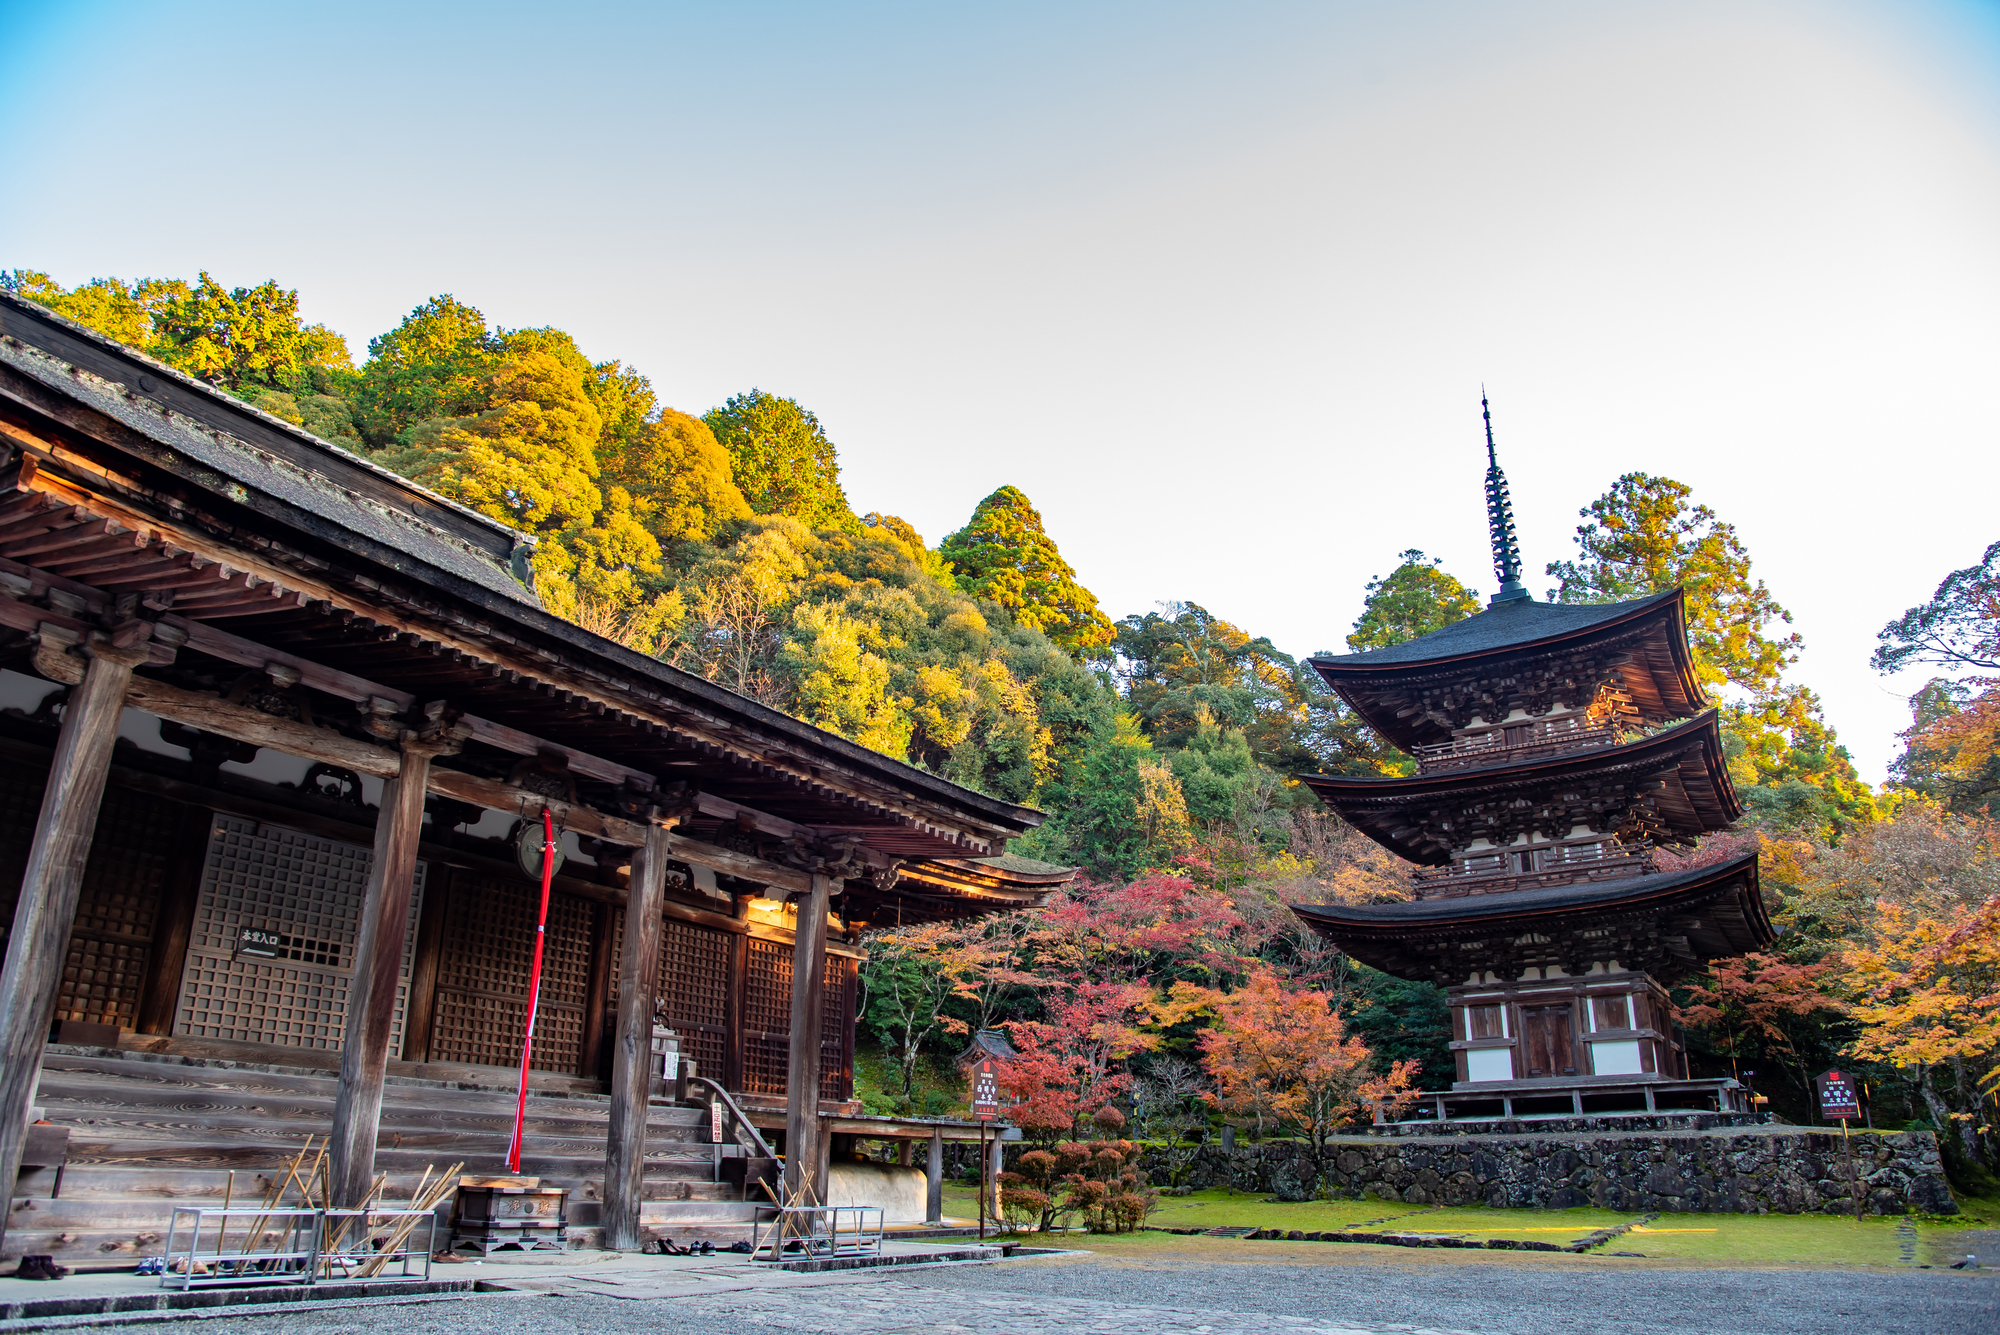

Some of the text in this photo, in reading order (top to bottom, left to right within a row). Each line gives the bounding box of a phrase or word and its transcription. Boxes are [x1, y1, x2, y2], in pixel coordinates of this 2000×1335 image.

[242, 930, 278, 945] 本堂入口
[977, 1084, 996, 1094] 西明寺
[1822, 1090, 1852, 1098] 西明寺
